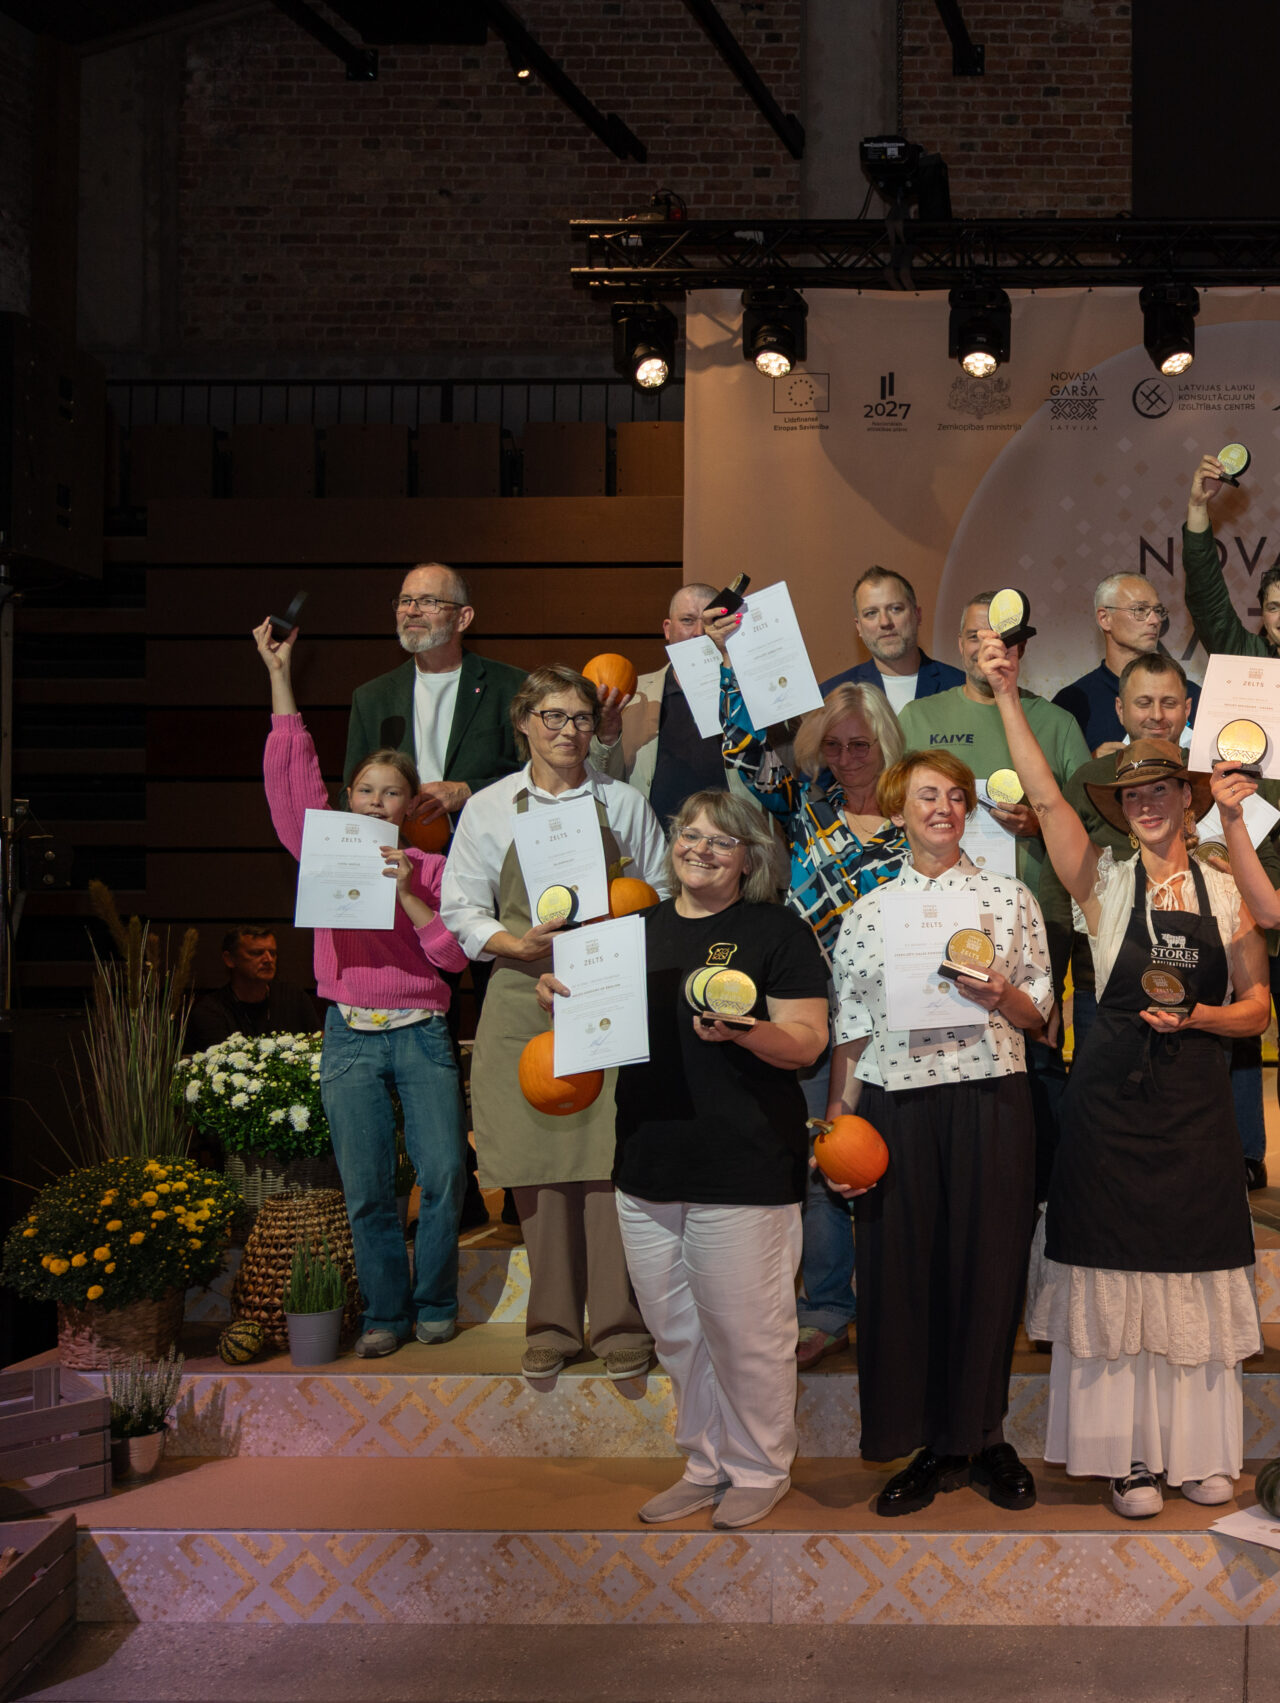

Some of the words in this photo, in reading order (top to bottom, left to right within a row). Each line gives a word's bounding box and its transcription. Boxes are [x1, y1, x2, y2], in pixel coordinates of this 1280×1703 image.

[1050, 371, 1098, 381] NOVADA
[1050, 382, 1098, 397] GARŠA
[1178, 384, 1221, 392] LATVIJAS
[1225, 384, 1256, 392] LAUKU
[1178, 393, 1241, 401] KONSULTĀCIJU
[863, 401, 912, 420] 2027
[1223, 403, 1256, 411] CENTRS
[937, 423, 985, 433] Zemkopības
[986, 423, 1022, 433] ministrija
[1242, 680, 1265, 688] ZELTS
[929, 733, 975, 745] KAIVE
[340, 836, 362, 844] ZELTS
[920, 921, 944, 929] ZELTS
[960, 949, 980, 960] ZELTS
[1150, 947, 1199, 961] STORES
[583, 955, 604, 967] ZELTS
